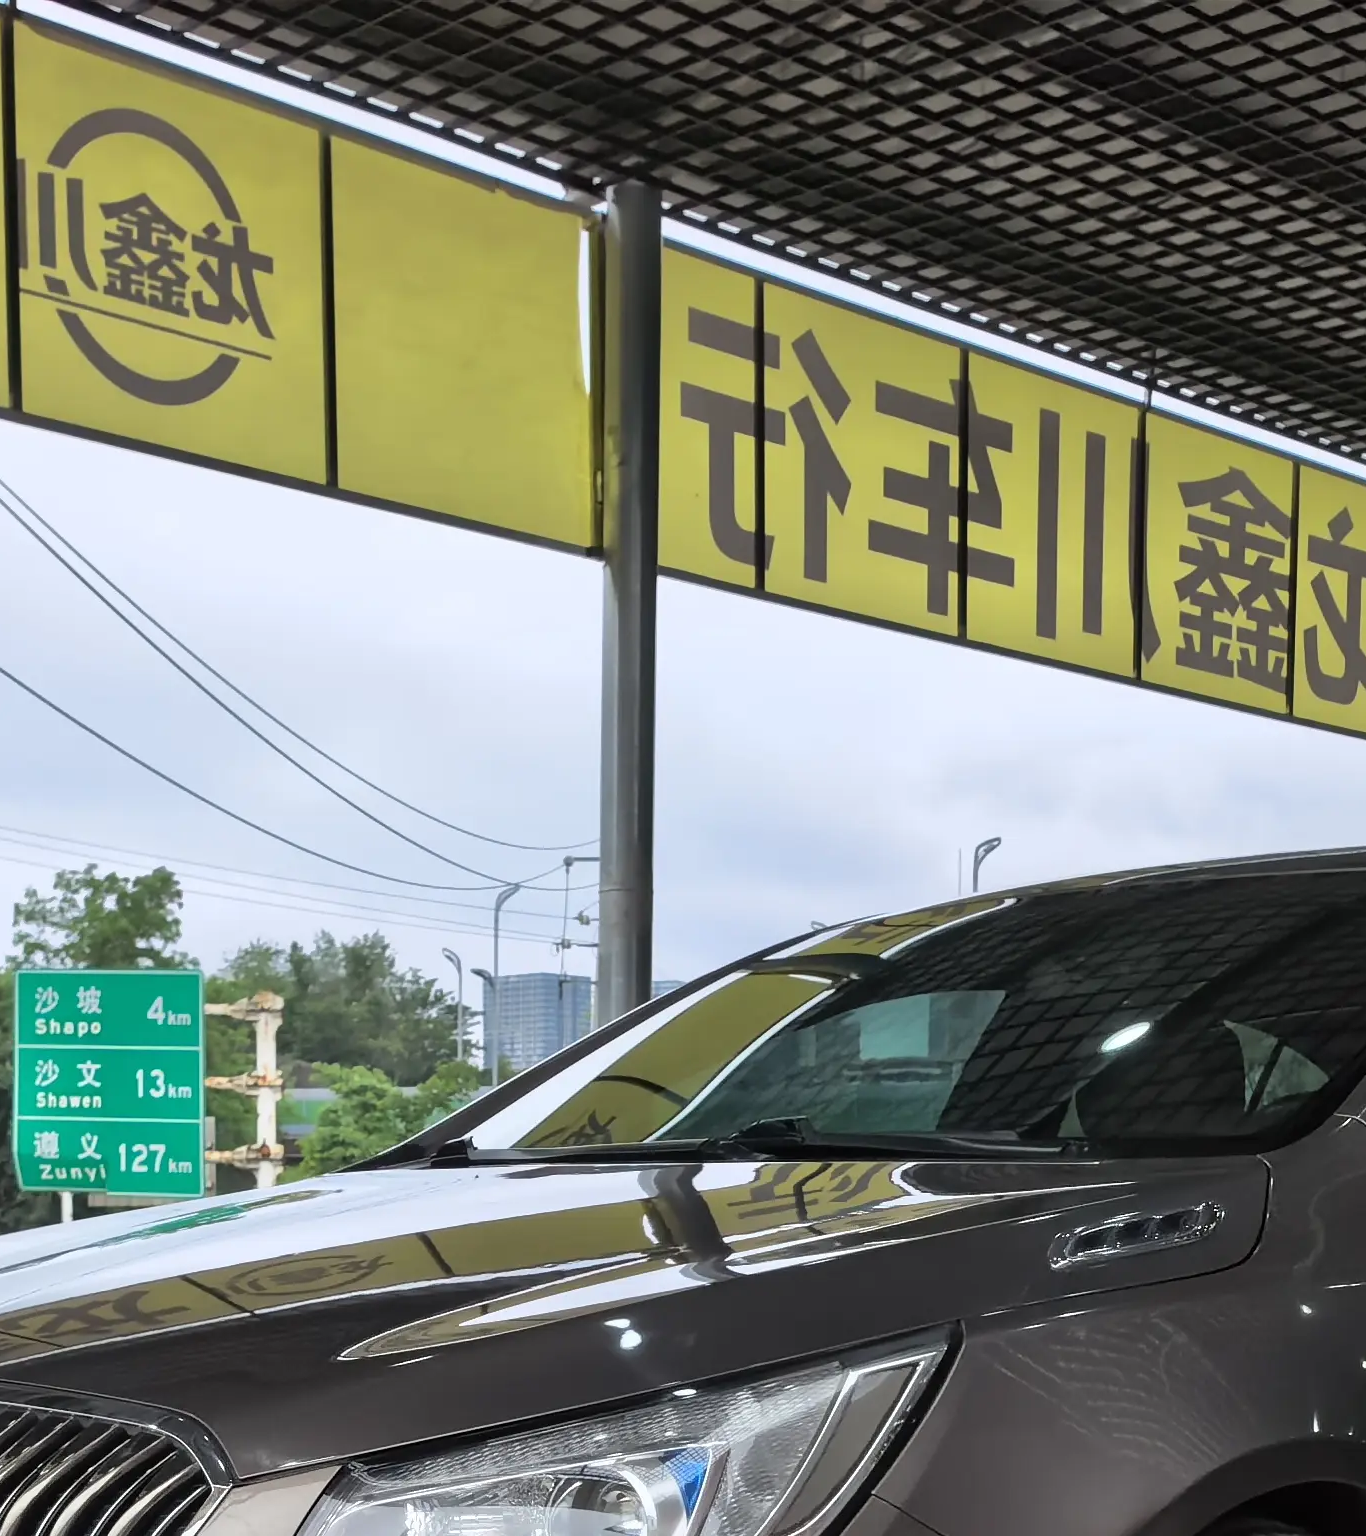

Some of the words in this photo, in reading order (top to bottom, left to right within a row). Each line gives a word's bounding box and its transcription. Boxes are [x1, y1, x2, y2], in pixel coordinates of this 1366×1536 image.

[35, 986, 102, 1014] 沙坡
[35, 1018, 102, 1038] Shapo
[35, 1059, 102, 1087] 沙文
[36, 1092, 102, 1109] Shawen
[39, 1164, 107, 1183] Zunyi
